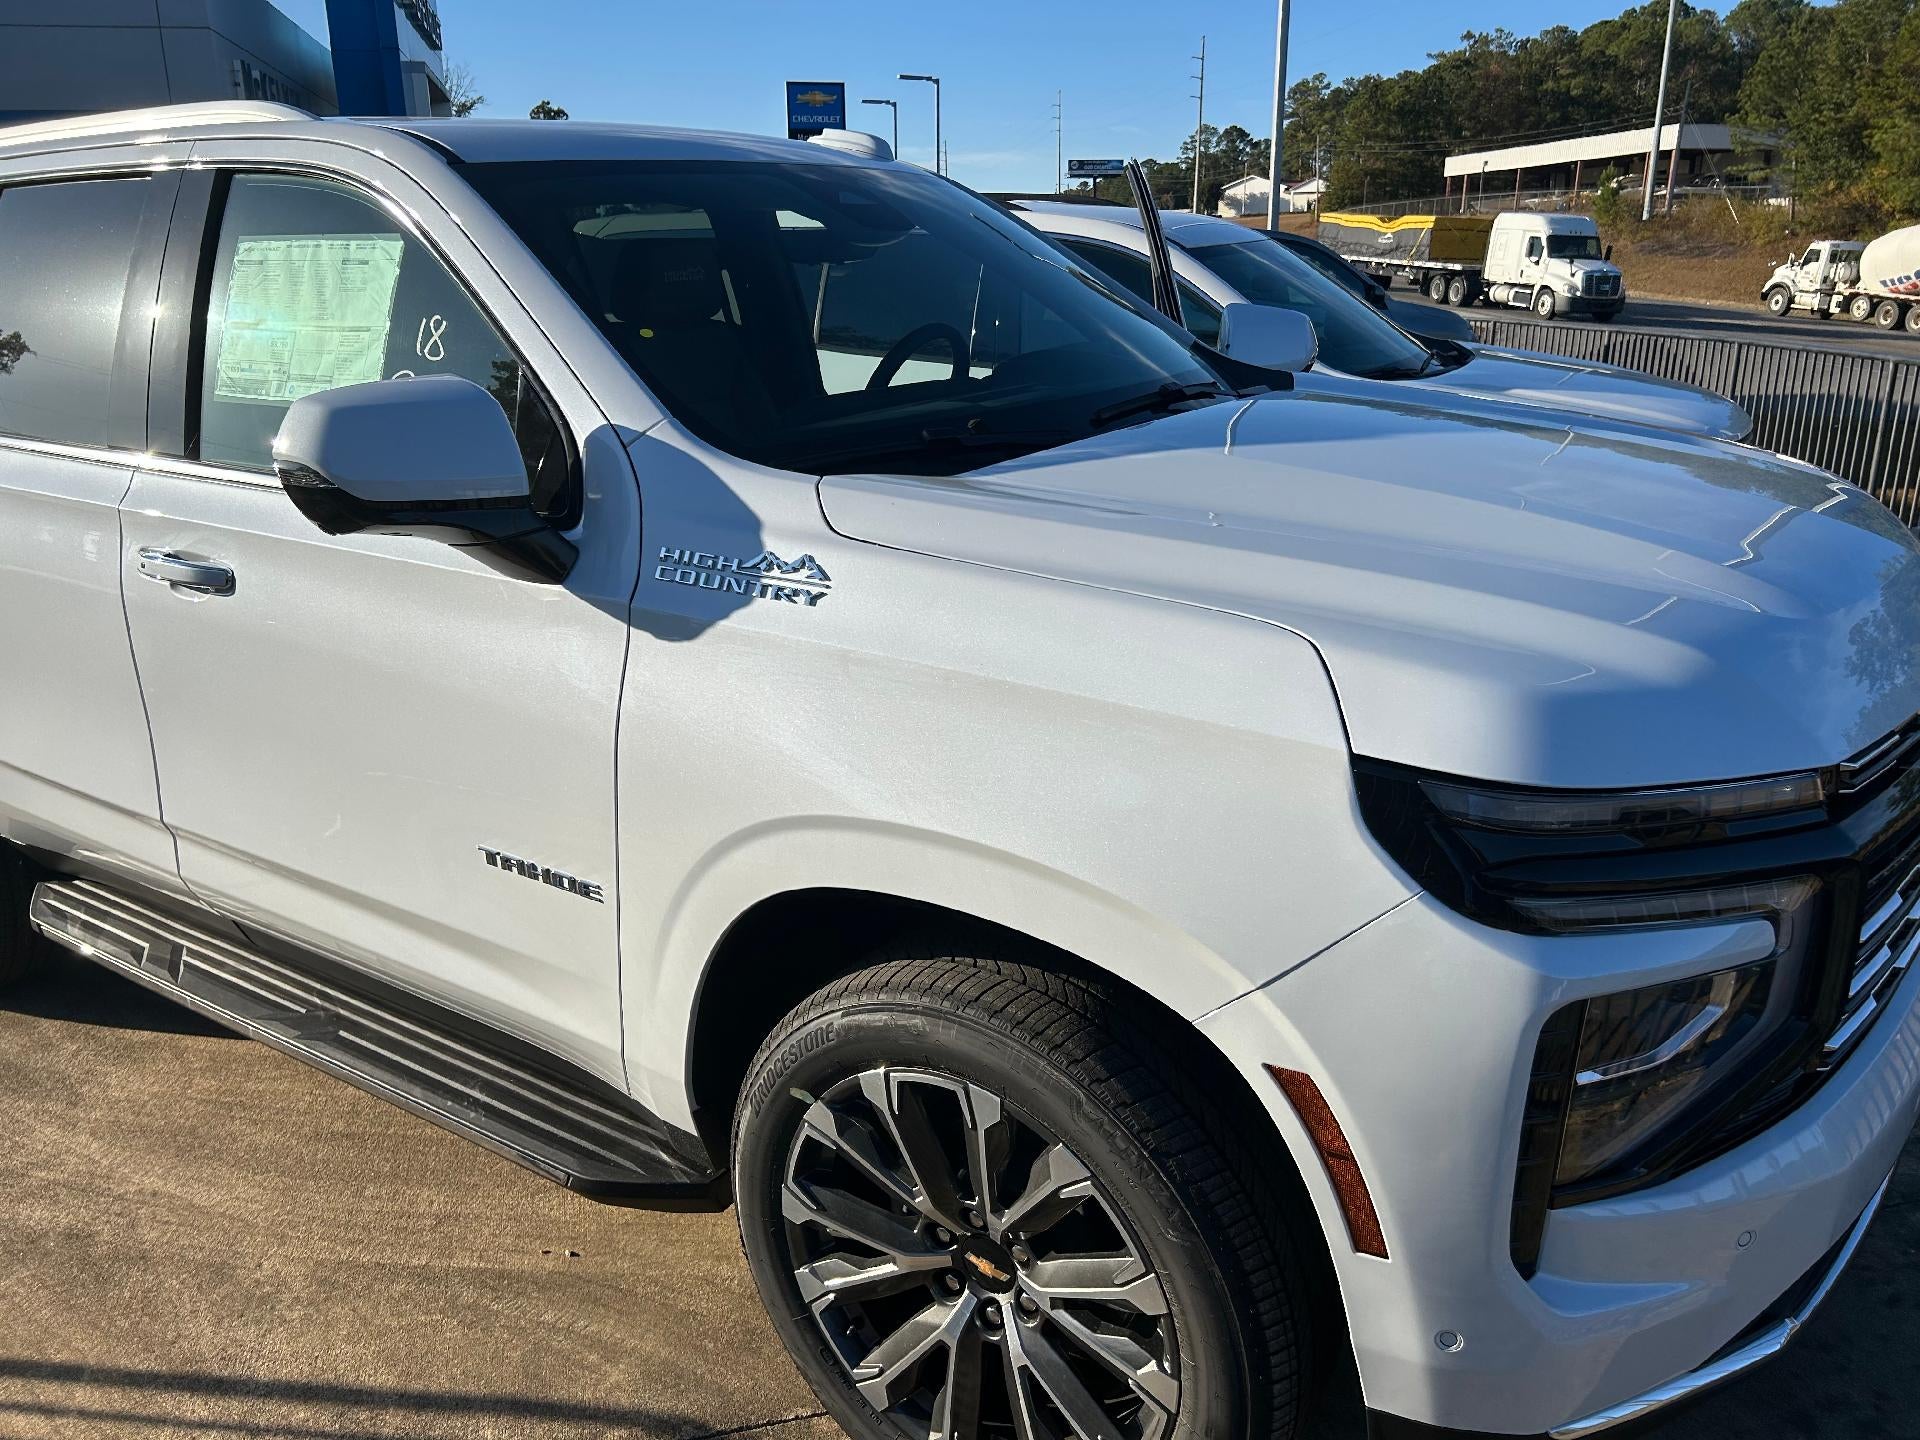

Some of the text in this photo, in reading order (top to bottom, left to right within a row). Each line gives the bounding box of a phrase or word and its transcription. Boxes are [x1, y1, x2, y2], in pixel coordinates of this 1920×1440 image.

[792, 115, 841, 123] CHEVROLET
[416, 314, 447, 361] 18
[658, 546, 741, 573] HIGH
[654, 565, 829, 608] COUNTRY
[477, 844, 605, 905] TAHOE
[749, 1021, 836, 1120] BRIDGESTONE
